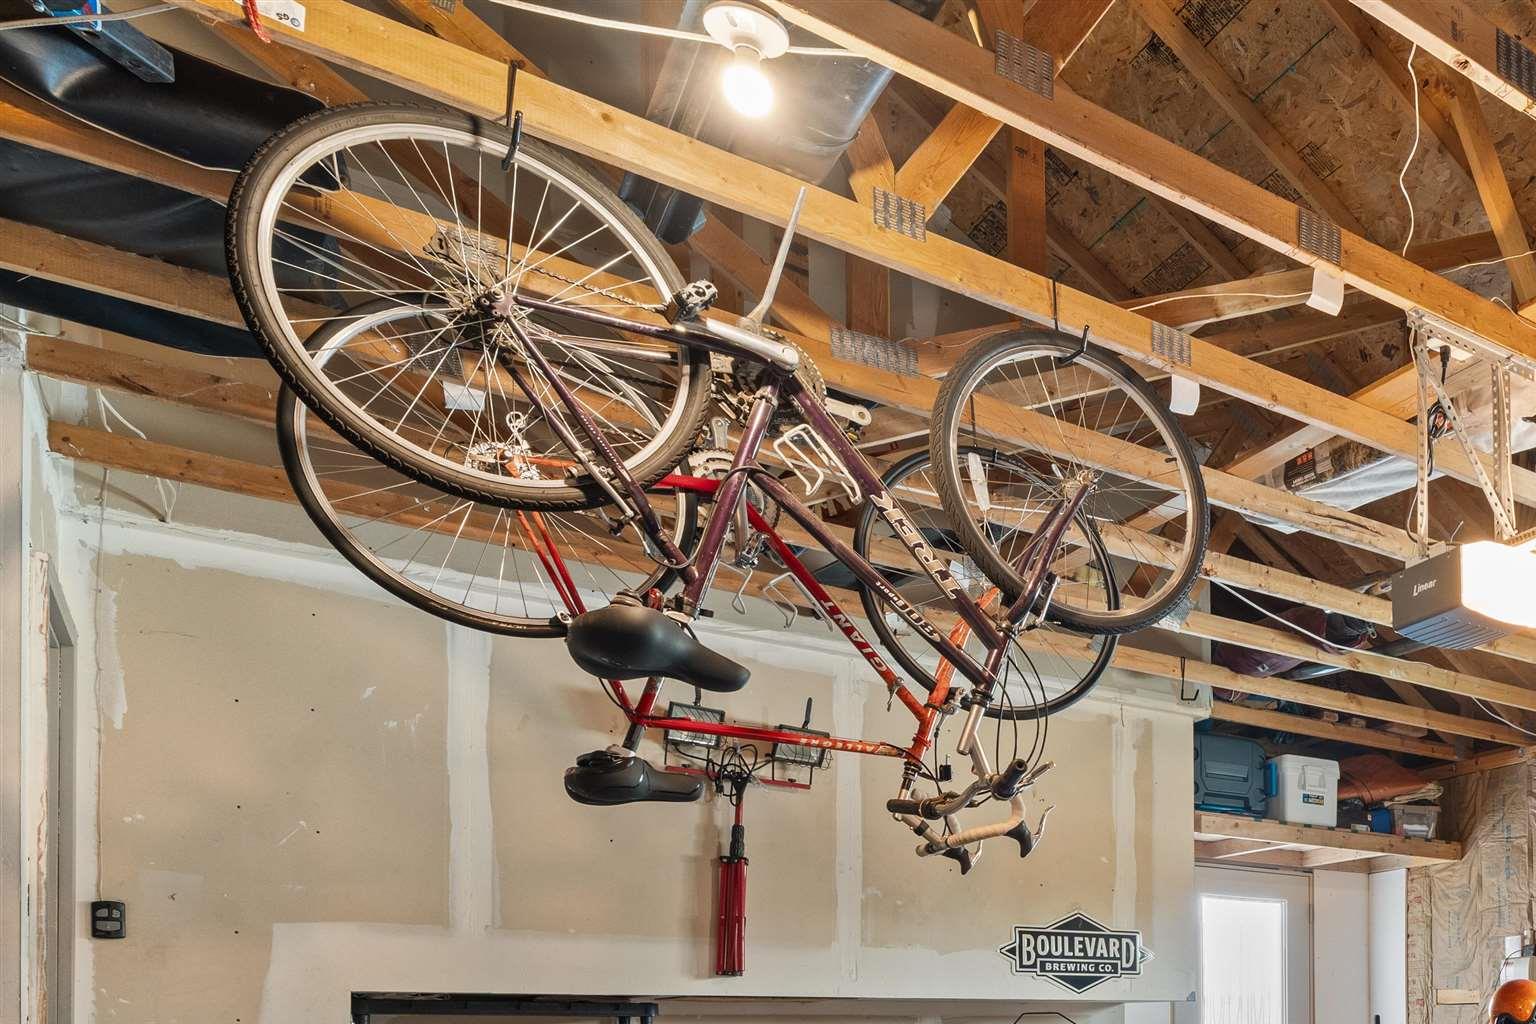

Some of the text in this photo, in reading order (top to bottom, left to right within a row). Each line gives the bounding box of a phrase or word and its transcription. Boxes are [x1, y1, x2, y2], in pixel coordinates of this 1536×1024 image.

[870, 491, 961, 600] TREK
[1413, 579, 1437, 596] Linear
[822, 600, 889, 672] GIANT
[1021, 933, 1135, 968] BOULEVARD
[1045, 962, 1114, 972] BREWING CO.
